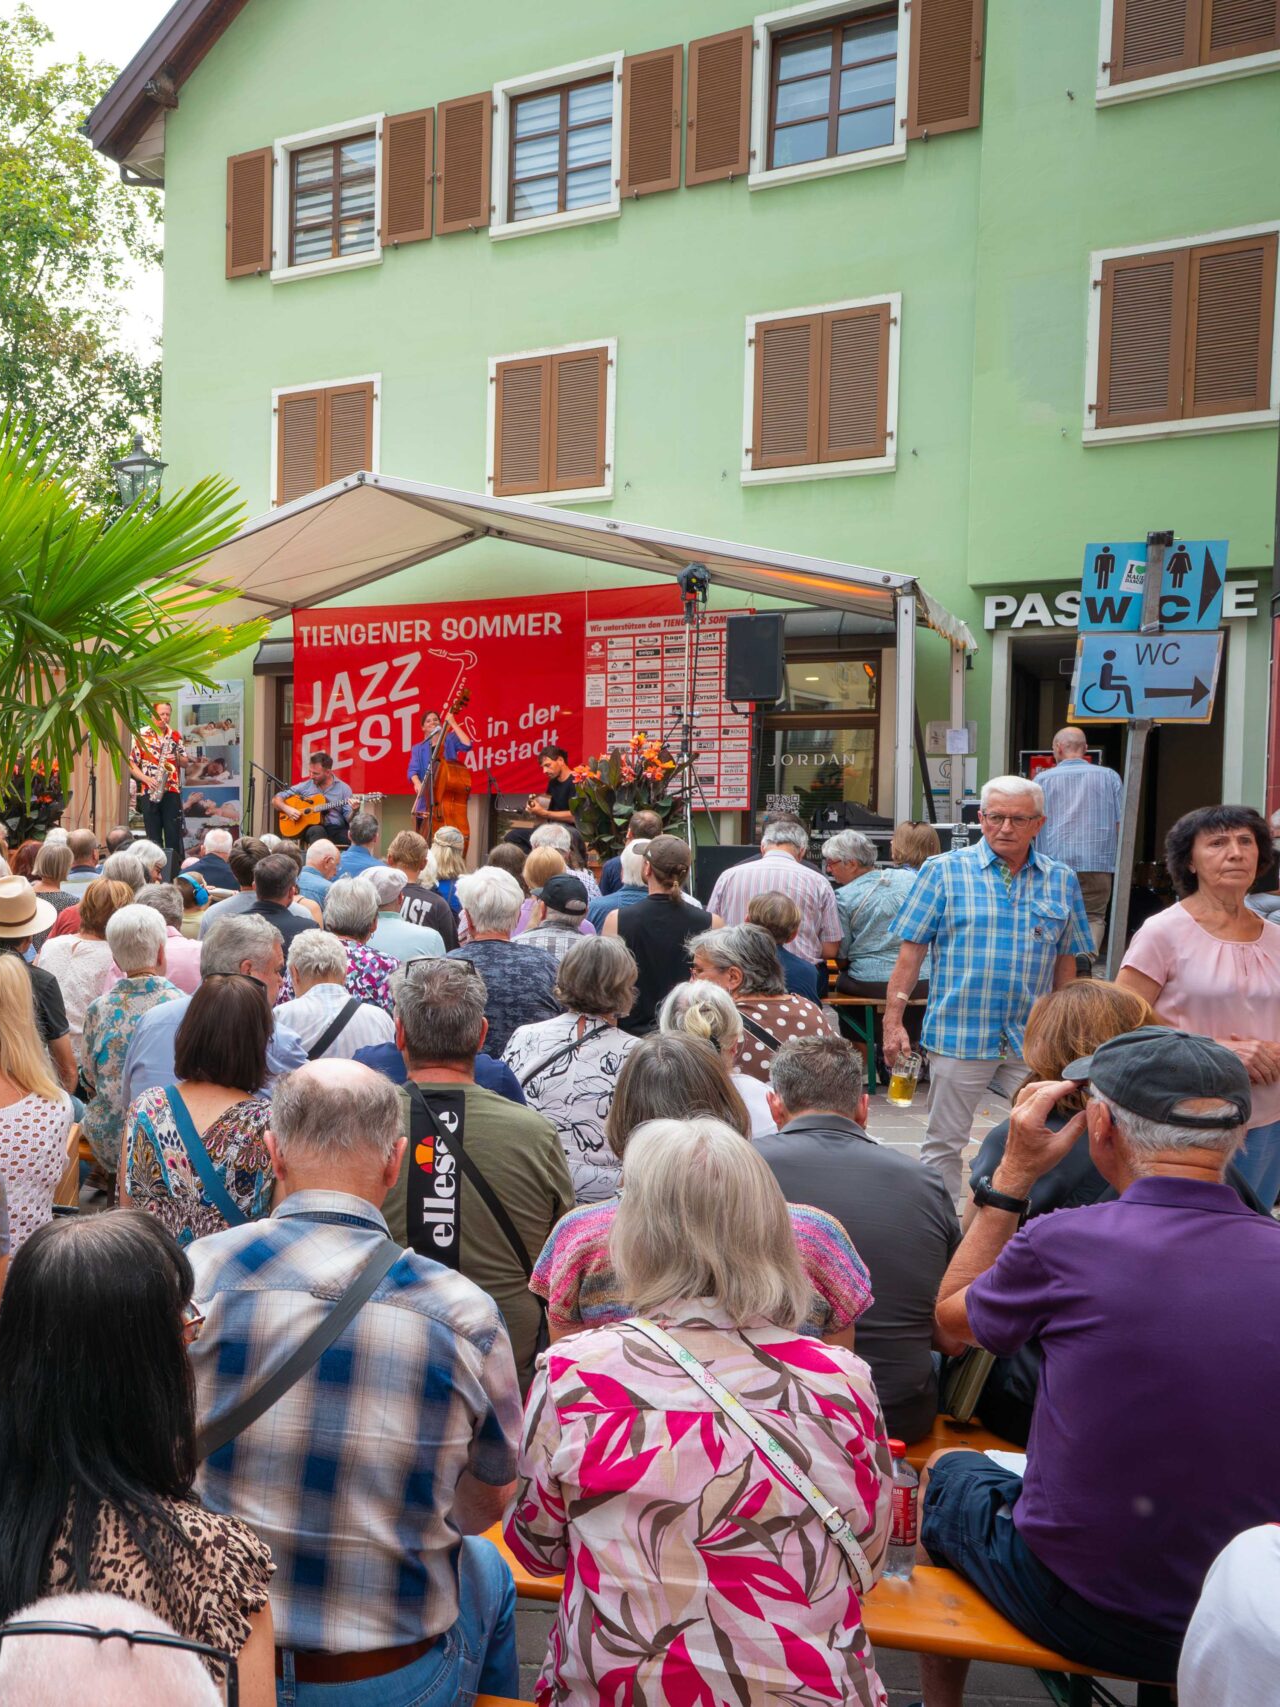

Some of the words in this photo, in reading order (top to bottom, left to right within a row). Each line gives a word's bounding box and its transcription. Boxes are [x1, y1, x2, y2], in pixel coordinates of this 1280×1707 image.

[984, 580, 1258, 630] PASE
[299, 619, 431, 648] TIENGENER
[441, 612, 562, 640] SOMMER
[590, 624, 602, 632] Wir
[604, 622, 646, 632] unterstützen
[648, 620, 661, 629] den
[1136, 642, 1181, 665] WC
[304, 651, 422, 727] JAZZ
[487, 717, 508, 738] in
[519, 703, 560, 730] der
[301, 704, 420, 778] FEST
[464, 729, 559, 773] Altstadt
[767, 753, 855, 766] JORDAN
[423, 1111, 459, 1248] ellesse
